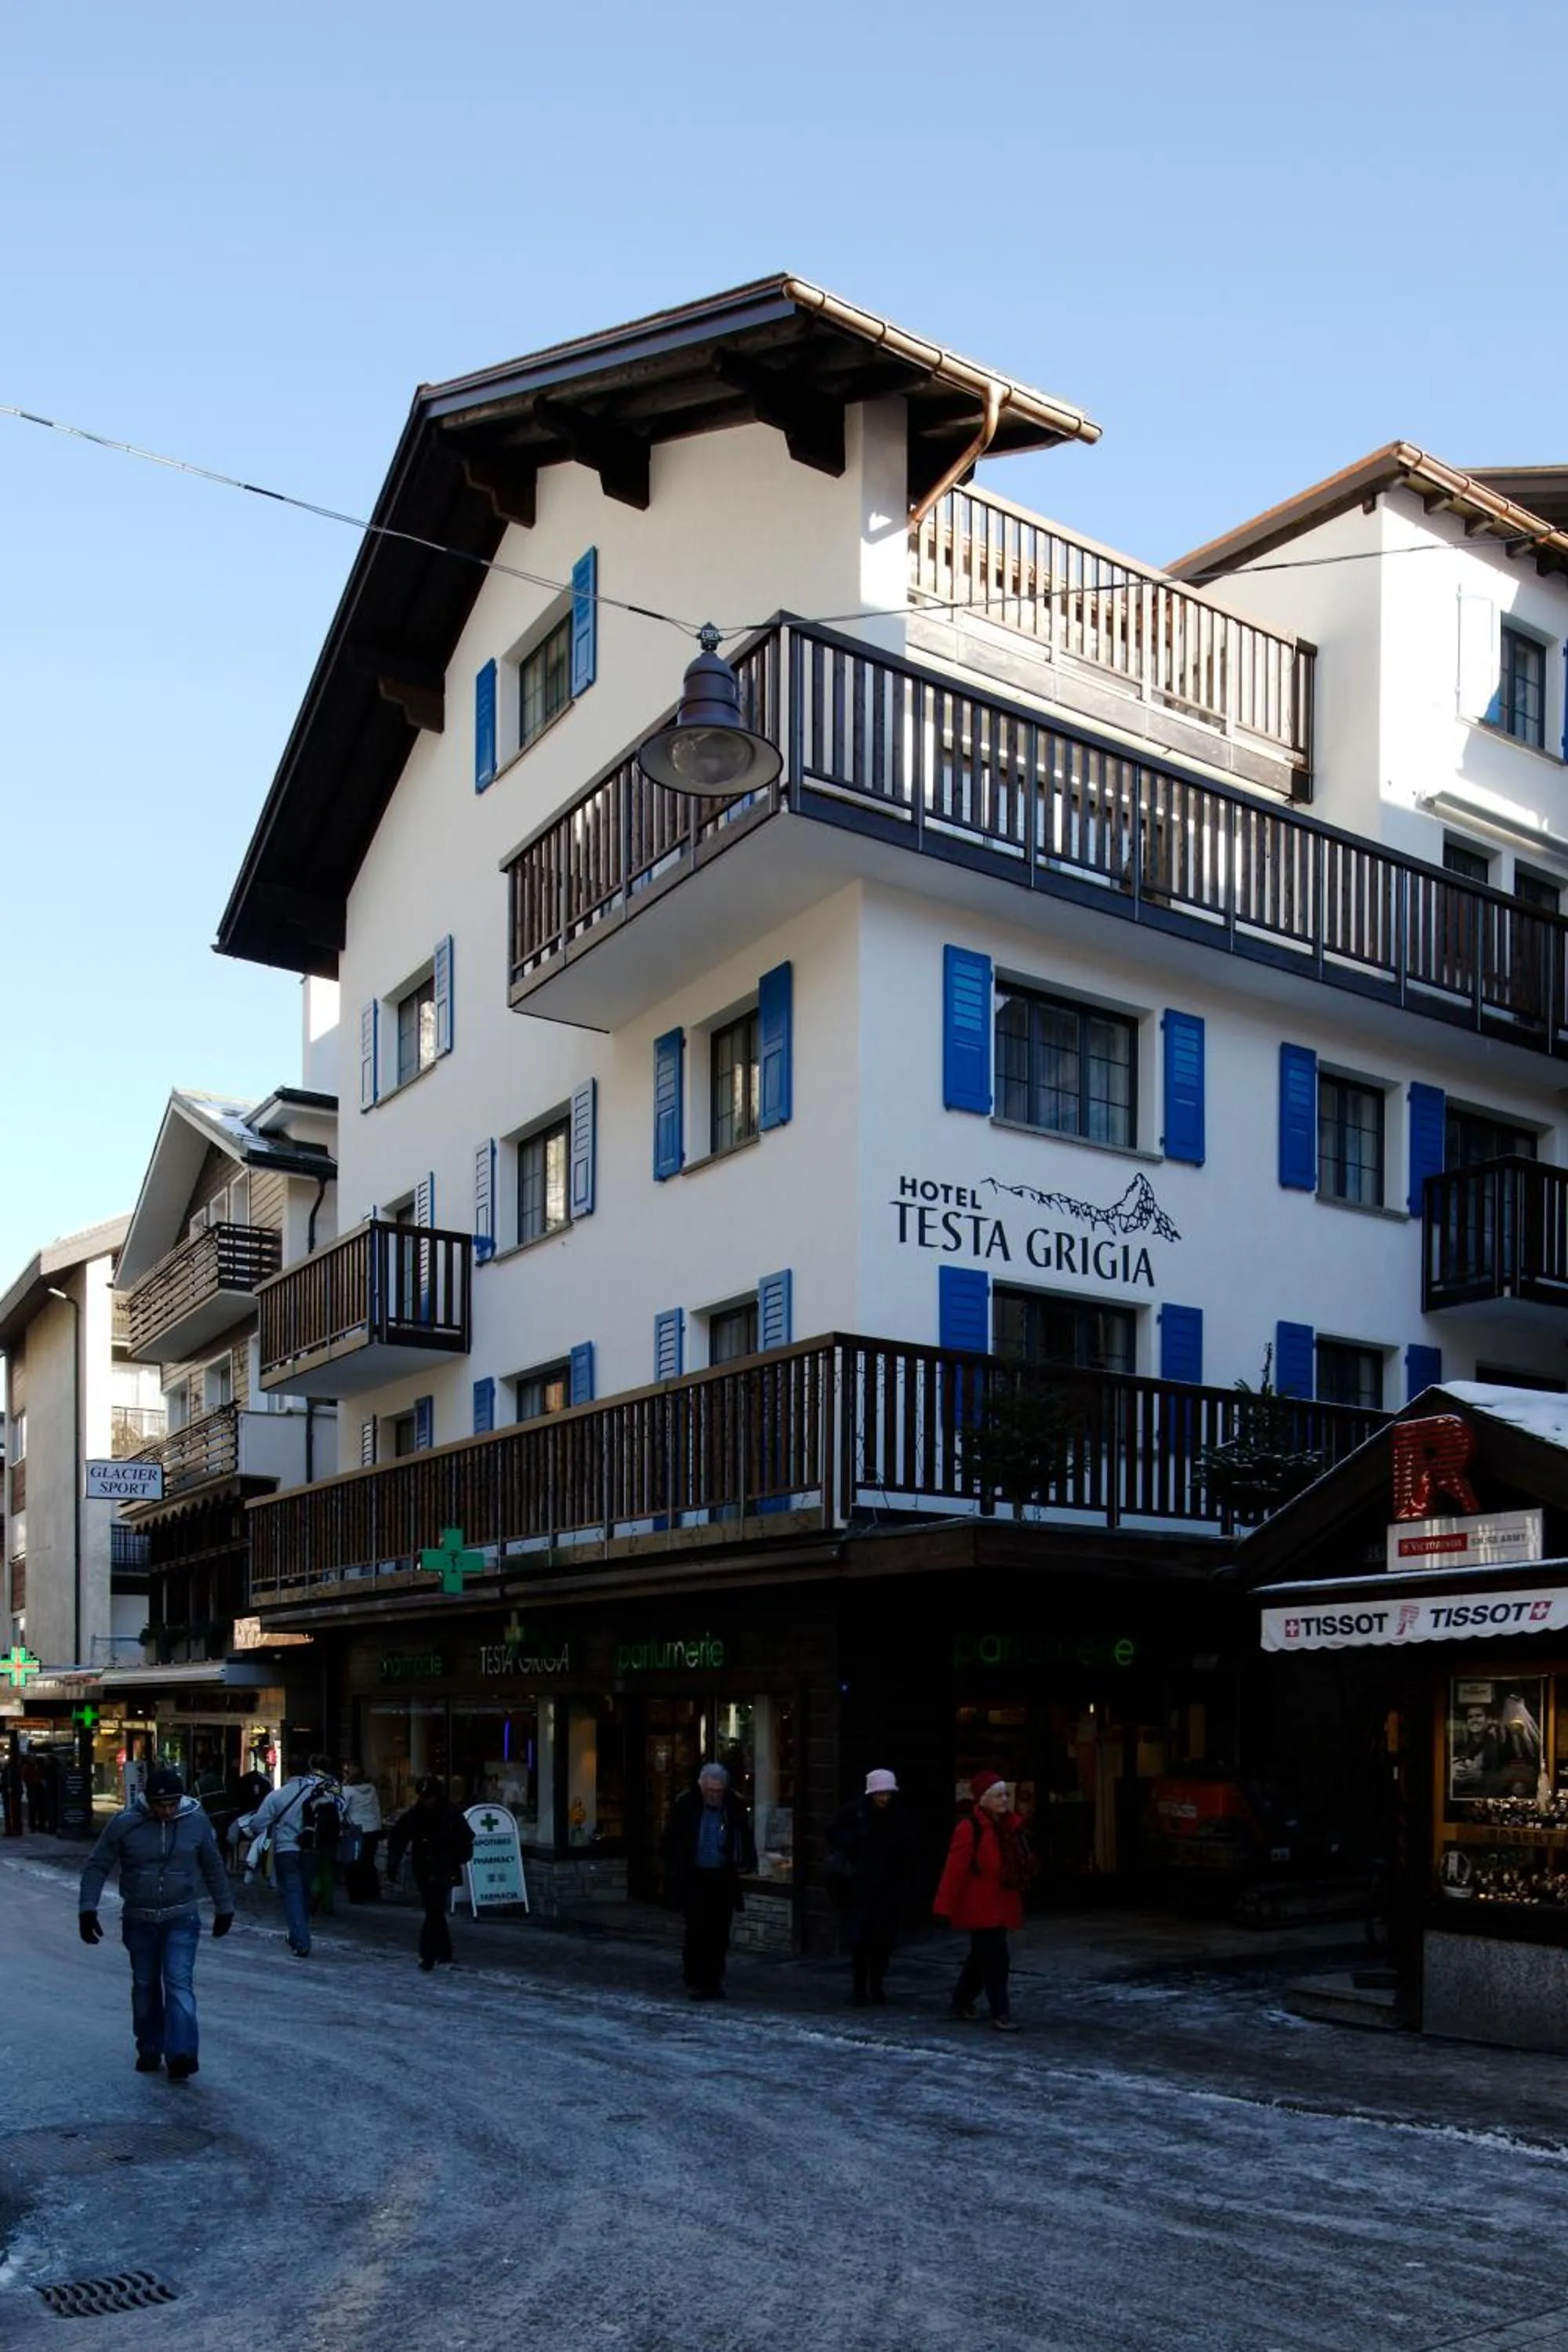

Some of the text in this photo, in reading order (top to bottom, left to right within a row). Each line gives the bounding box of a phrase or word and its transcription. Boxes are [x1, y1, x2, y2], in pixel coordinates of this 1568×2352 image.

[899, 1175, 982, 1210] HOTEL
[890, 1201, 1156, 1287] TESTA GRIGIA
[90, 1466, 157, 1481] GLACIER
[100, 1481, 150, 1494] SPORT
[1301, 1613, 1388, 1636] TISSOT
[1429, 1602, 1530, 1628] TISSOT
[480, 1644, 514, 1675] TESTA
[616, 1632, 723, 1676] parfumerie
